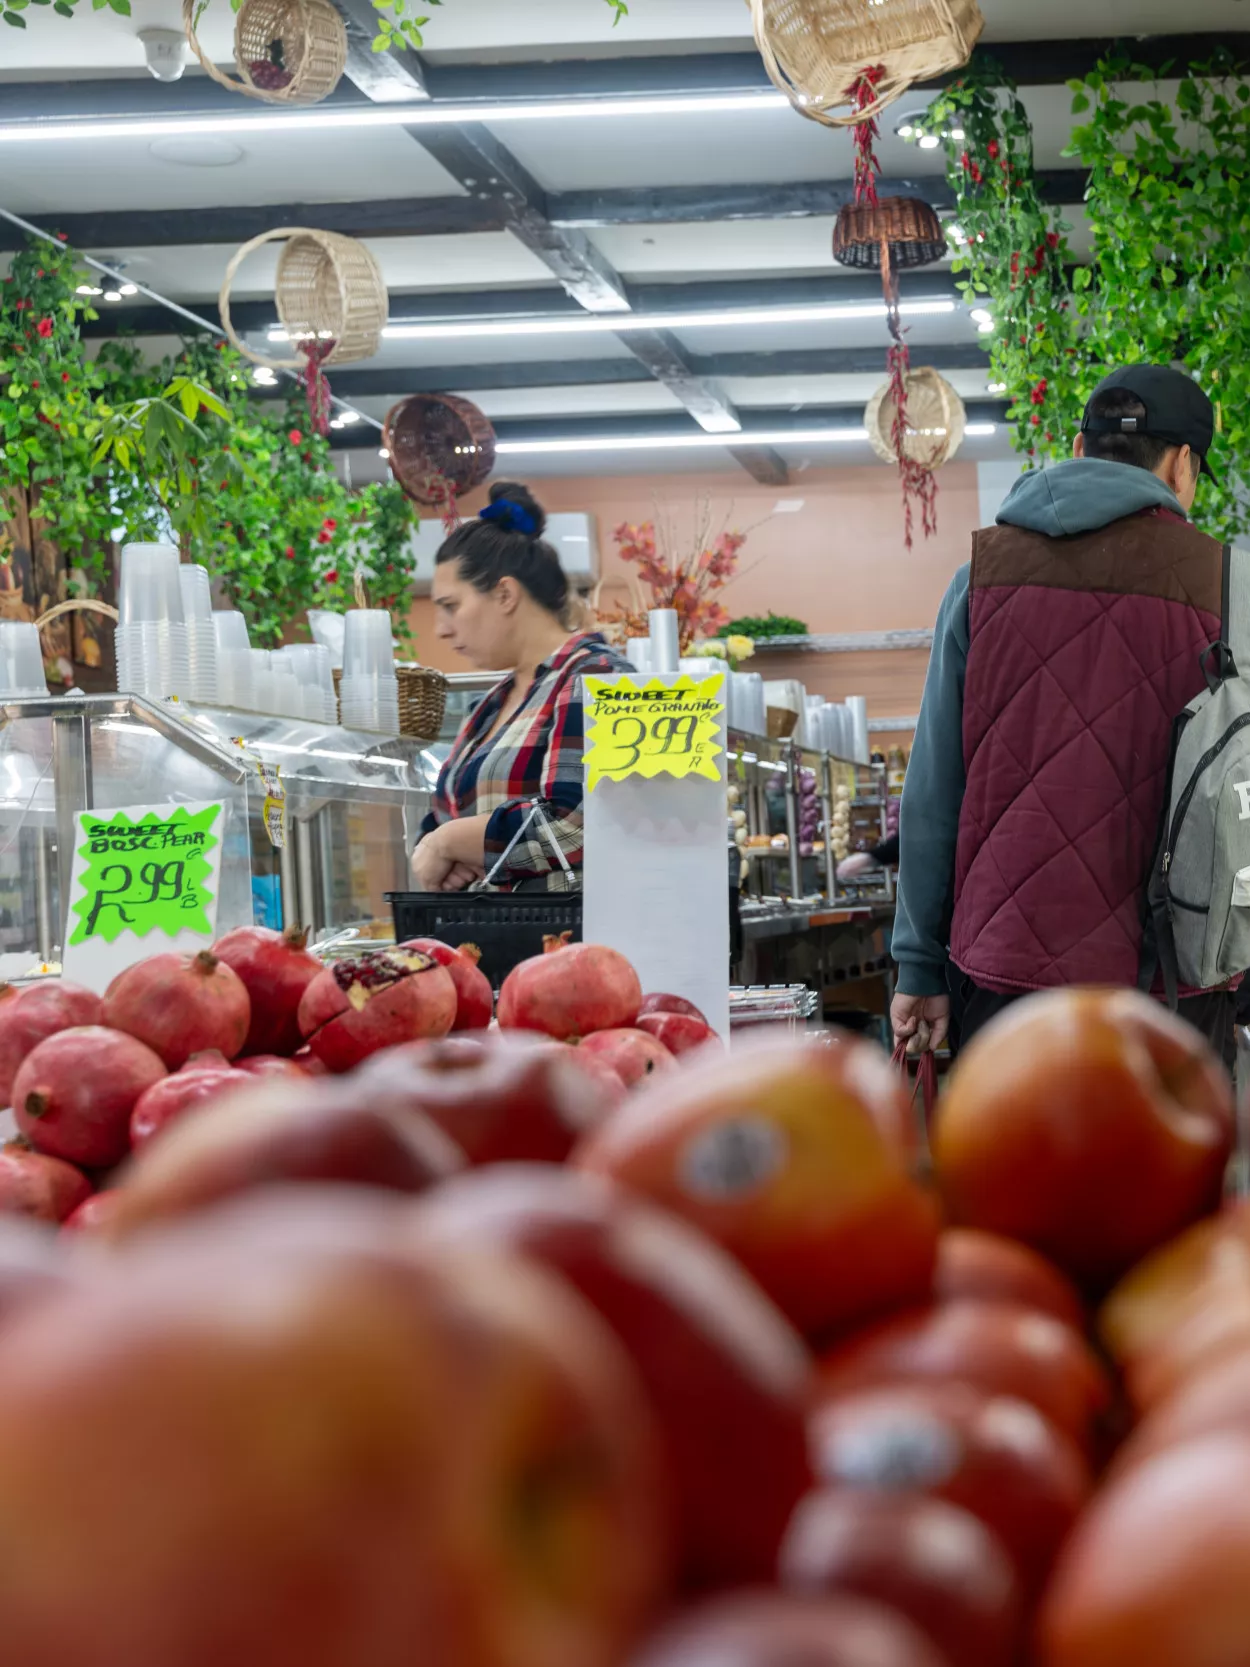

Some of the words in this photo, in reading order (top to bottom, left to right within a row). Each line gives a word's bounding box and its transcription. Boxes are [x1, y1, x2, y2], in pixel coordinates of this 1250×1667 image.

[596, 688, 696, 701] SWEET
[88, 823, 187, 837] SWEET
[161, 832, 206, 848] PEAR
